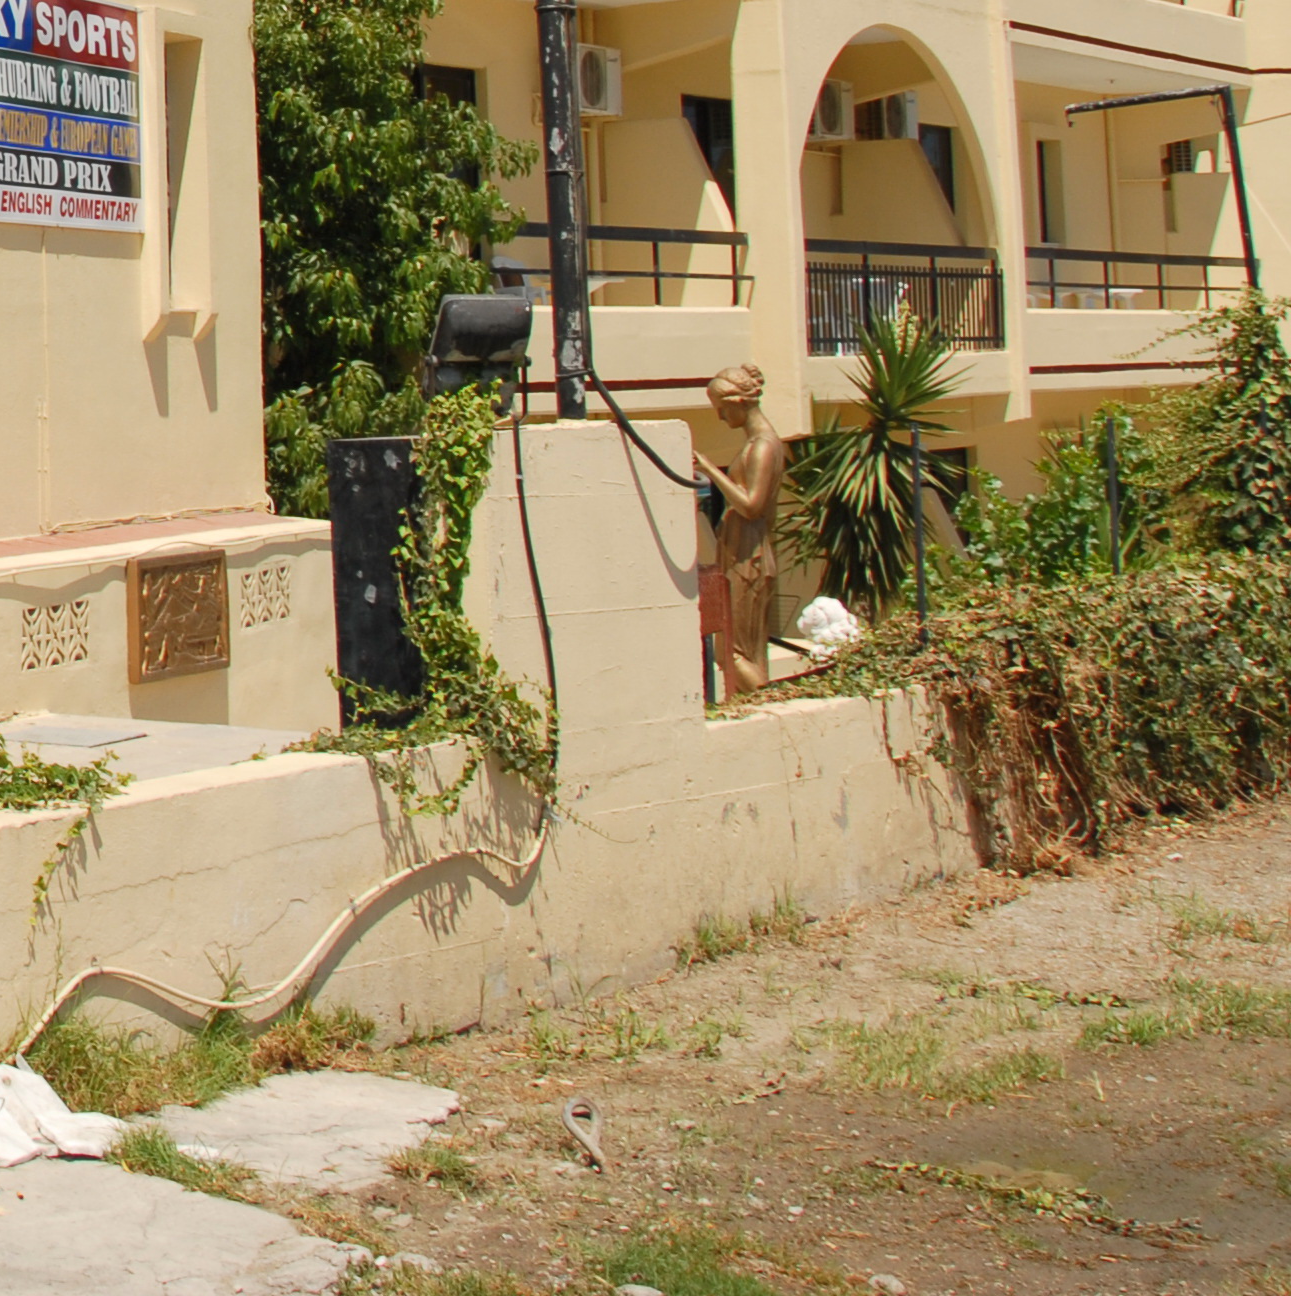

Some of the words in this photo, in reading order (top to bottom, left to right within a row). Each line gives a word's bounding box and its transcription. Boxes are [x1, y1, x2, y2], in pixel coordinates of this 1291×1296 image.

[35, 1, 136, 63] SPORTS
[60, 69, 72, 106] &
[74, 70, 138, 117] FOOTBALL
[49, 116, 59, 149] &
[61, 118, 109, 155] EUROPEAN
[63, 159, 112, 192] PRIX
[1, 190, 52, 216] ENGLISH
[59, 195, 138, 223] COMMENTARY
